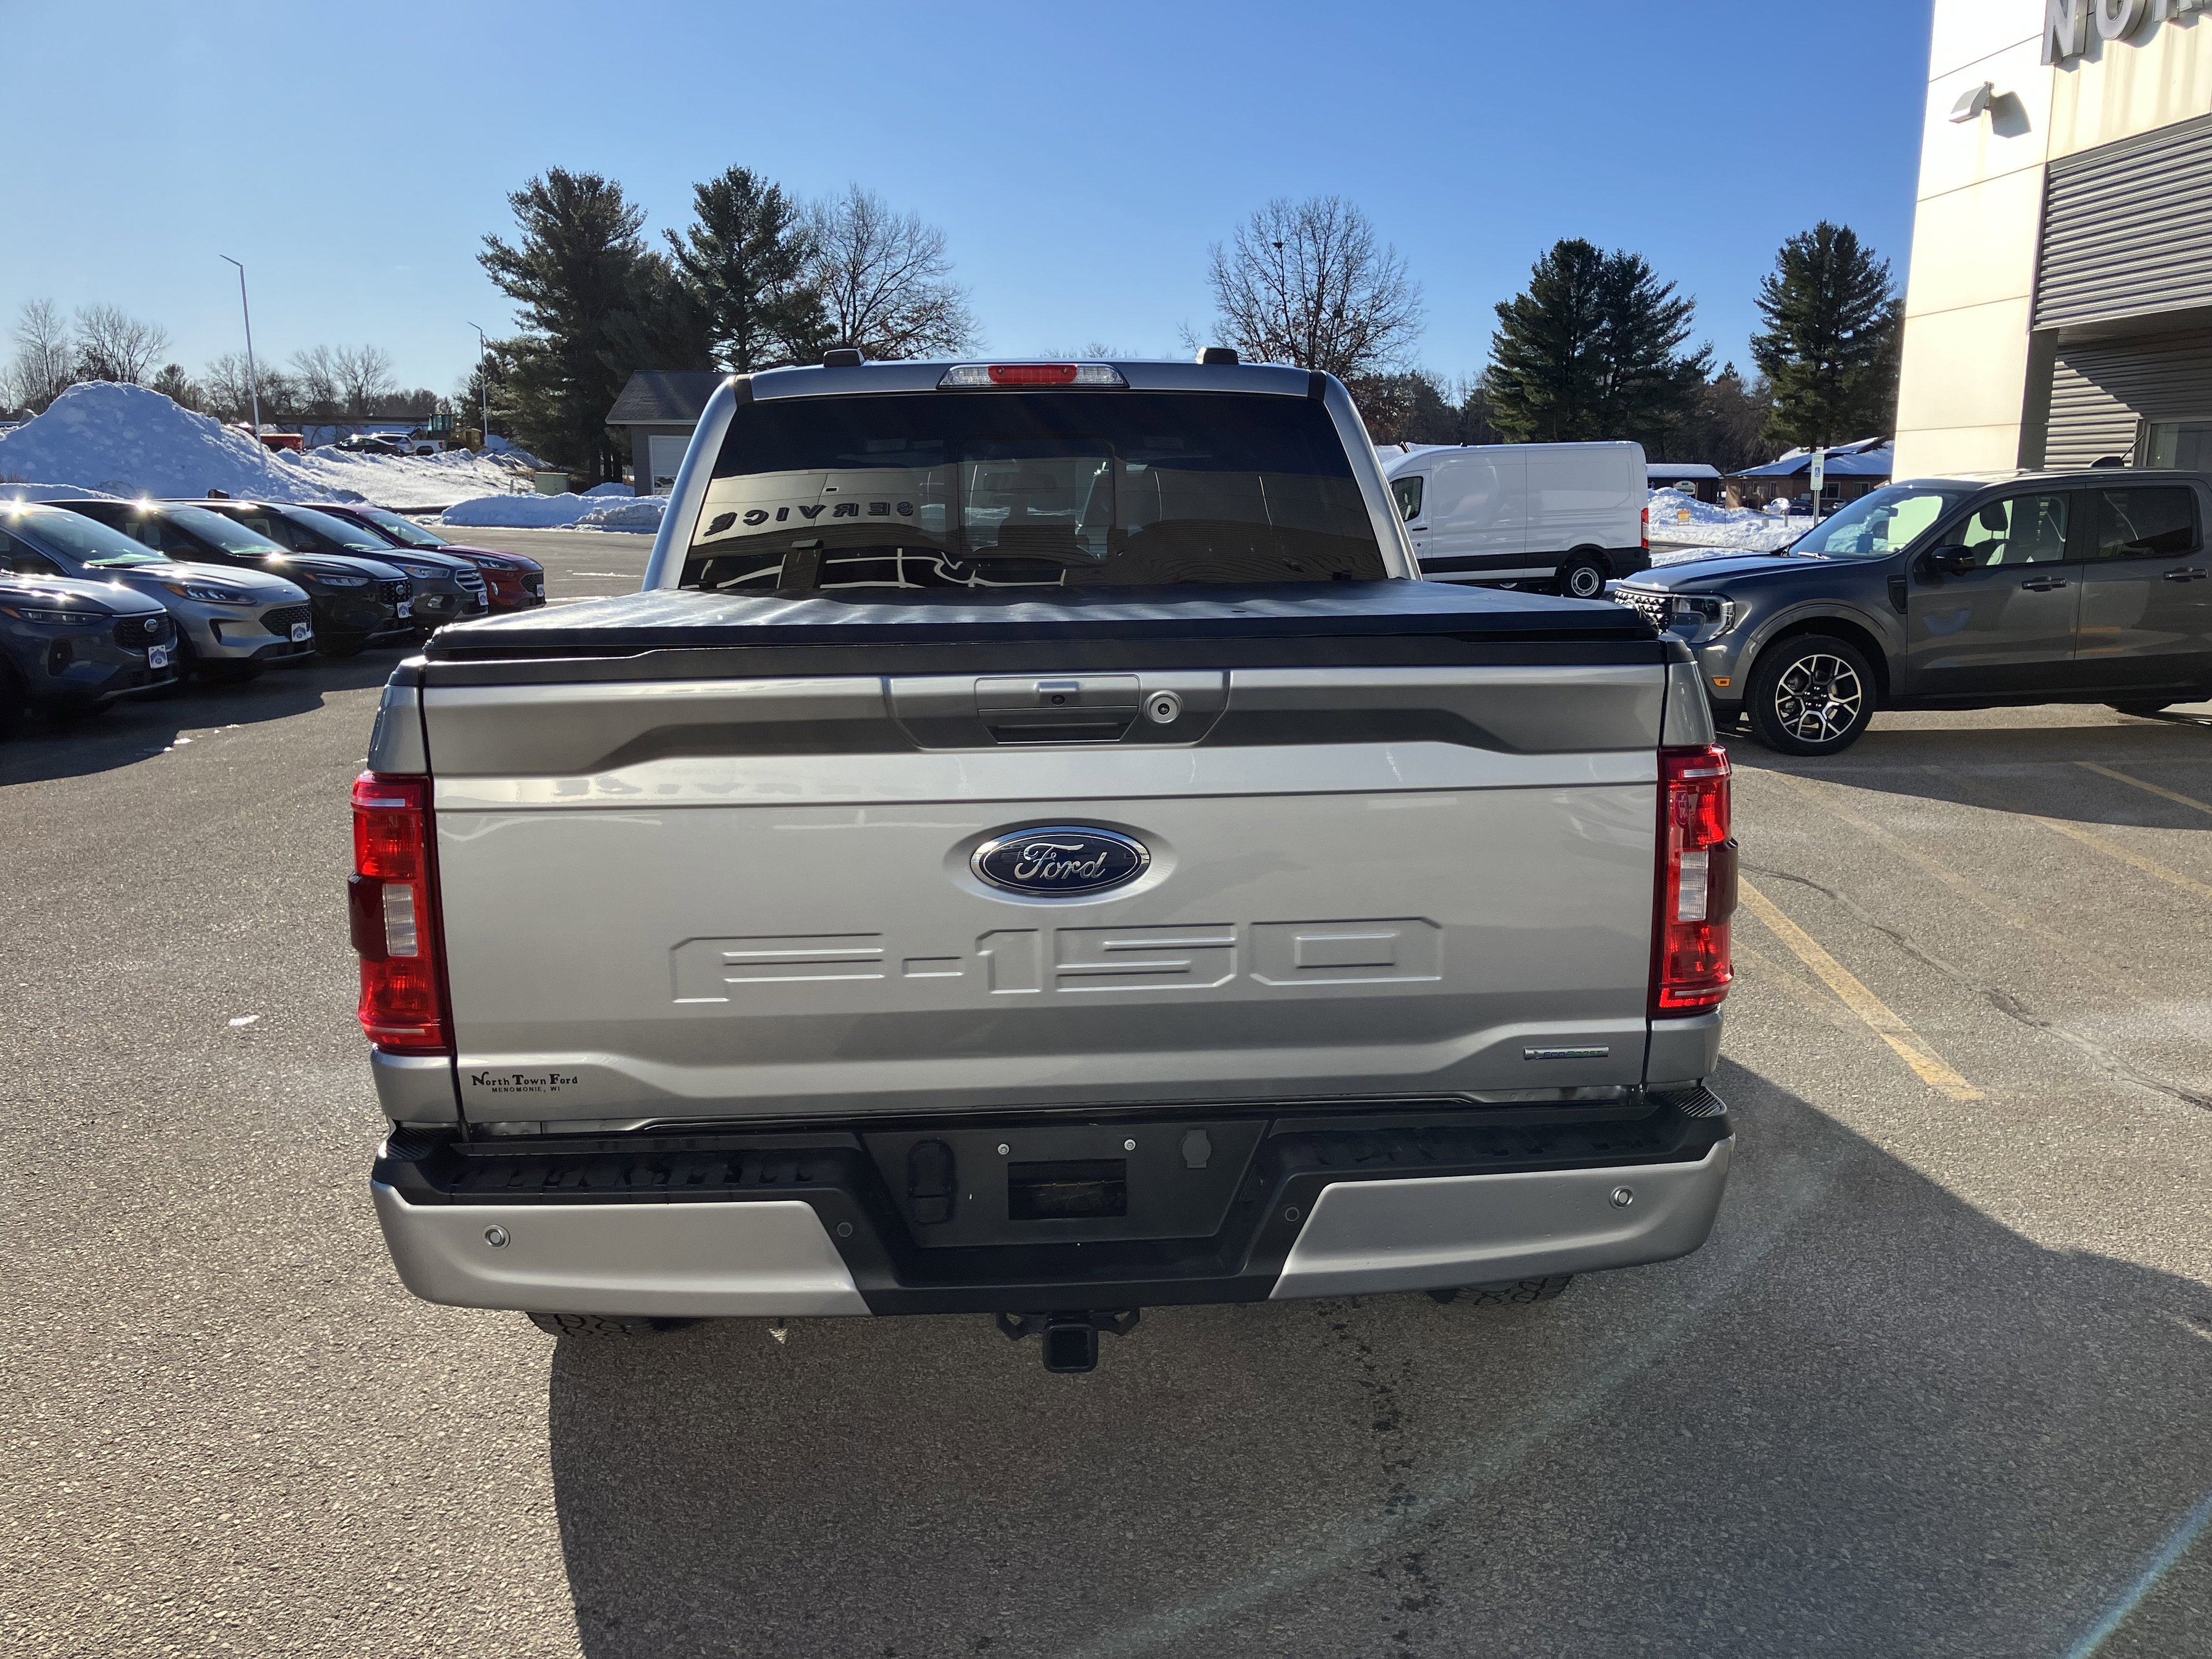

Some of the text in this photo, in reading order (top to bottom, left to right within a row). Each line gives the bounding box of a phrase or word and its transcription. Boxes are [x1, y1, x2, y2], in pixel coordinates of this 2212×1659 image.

[1014, 843, 1108, 879] Ford
[670, 917, 1443, 1003] F-150
[471, 1071, 578, 1086] North Town Ford
